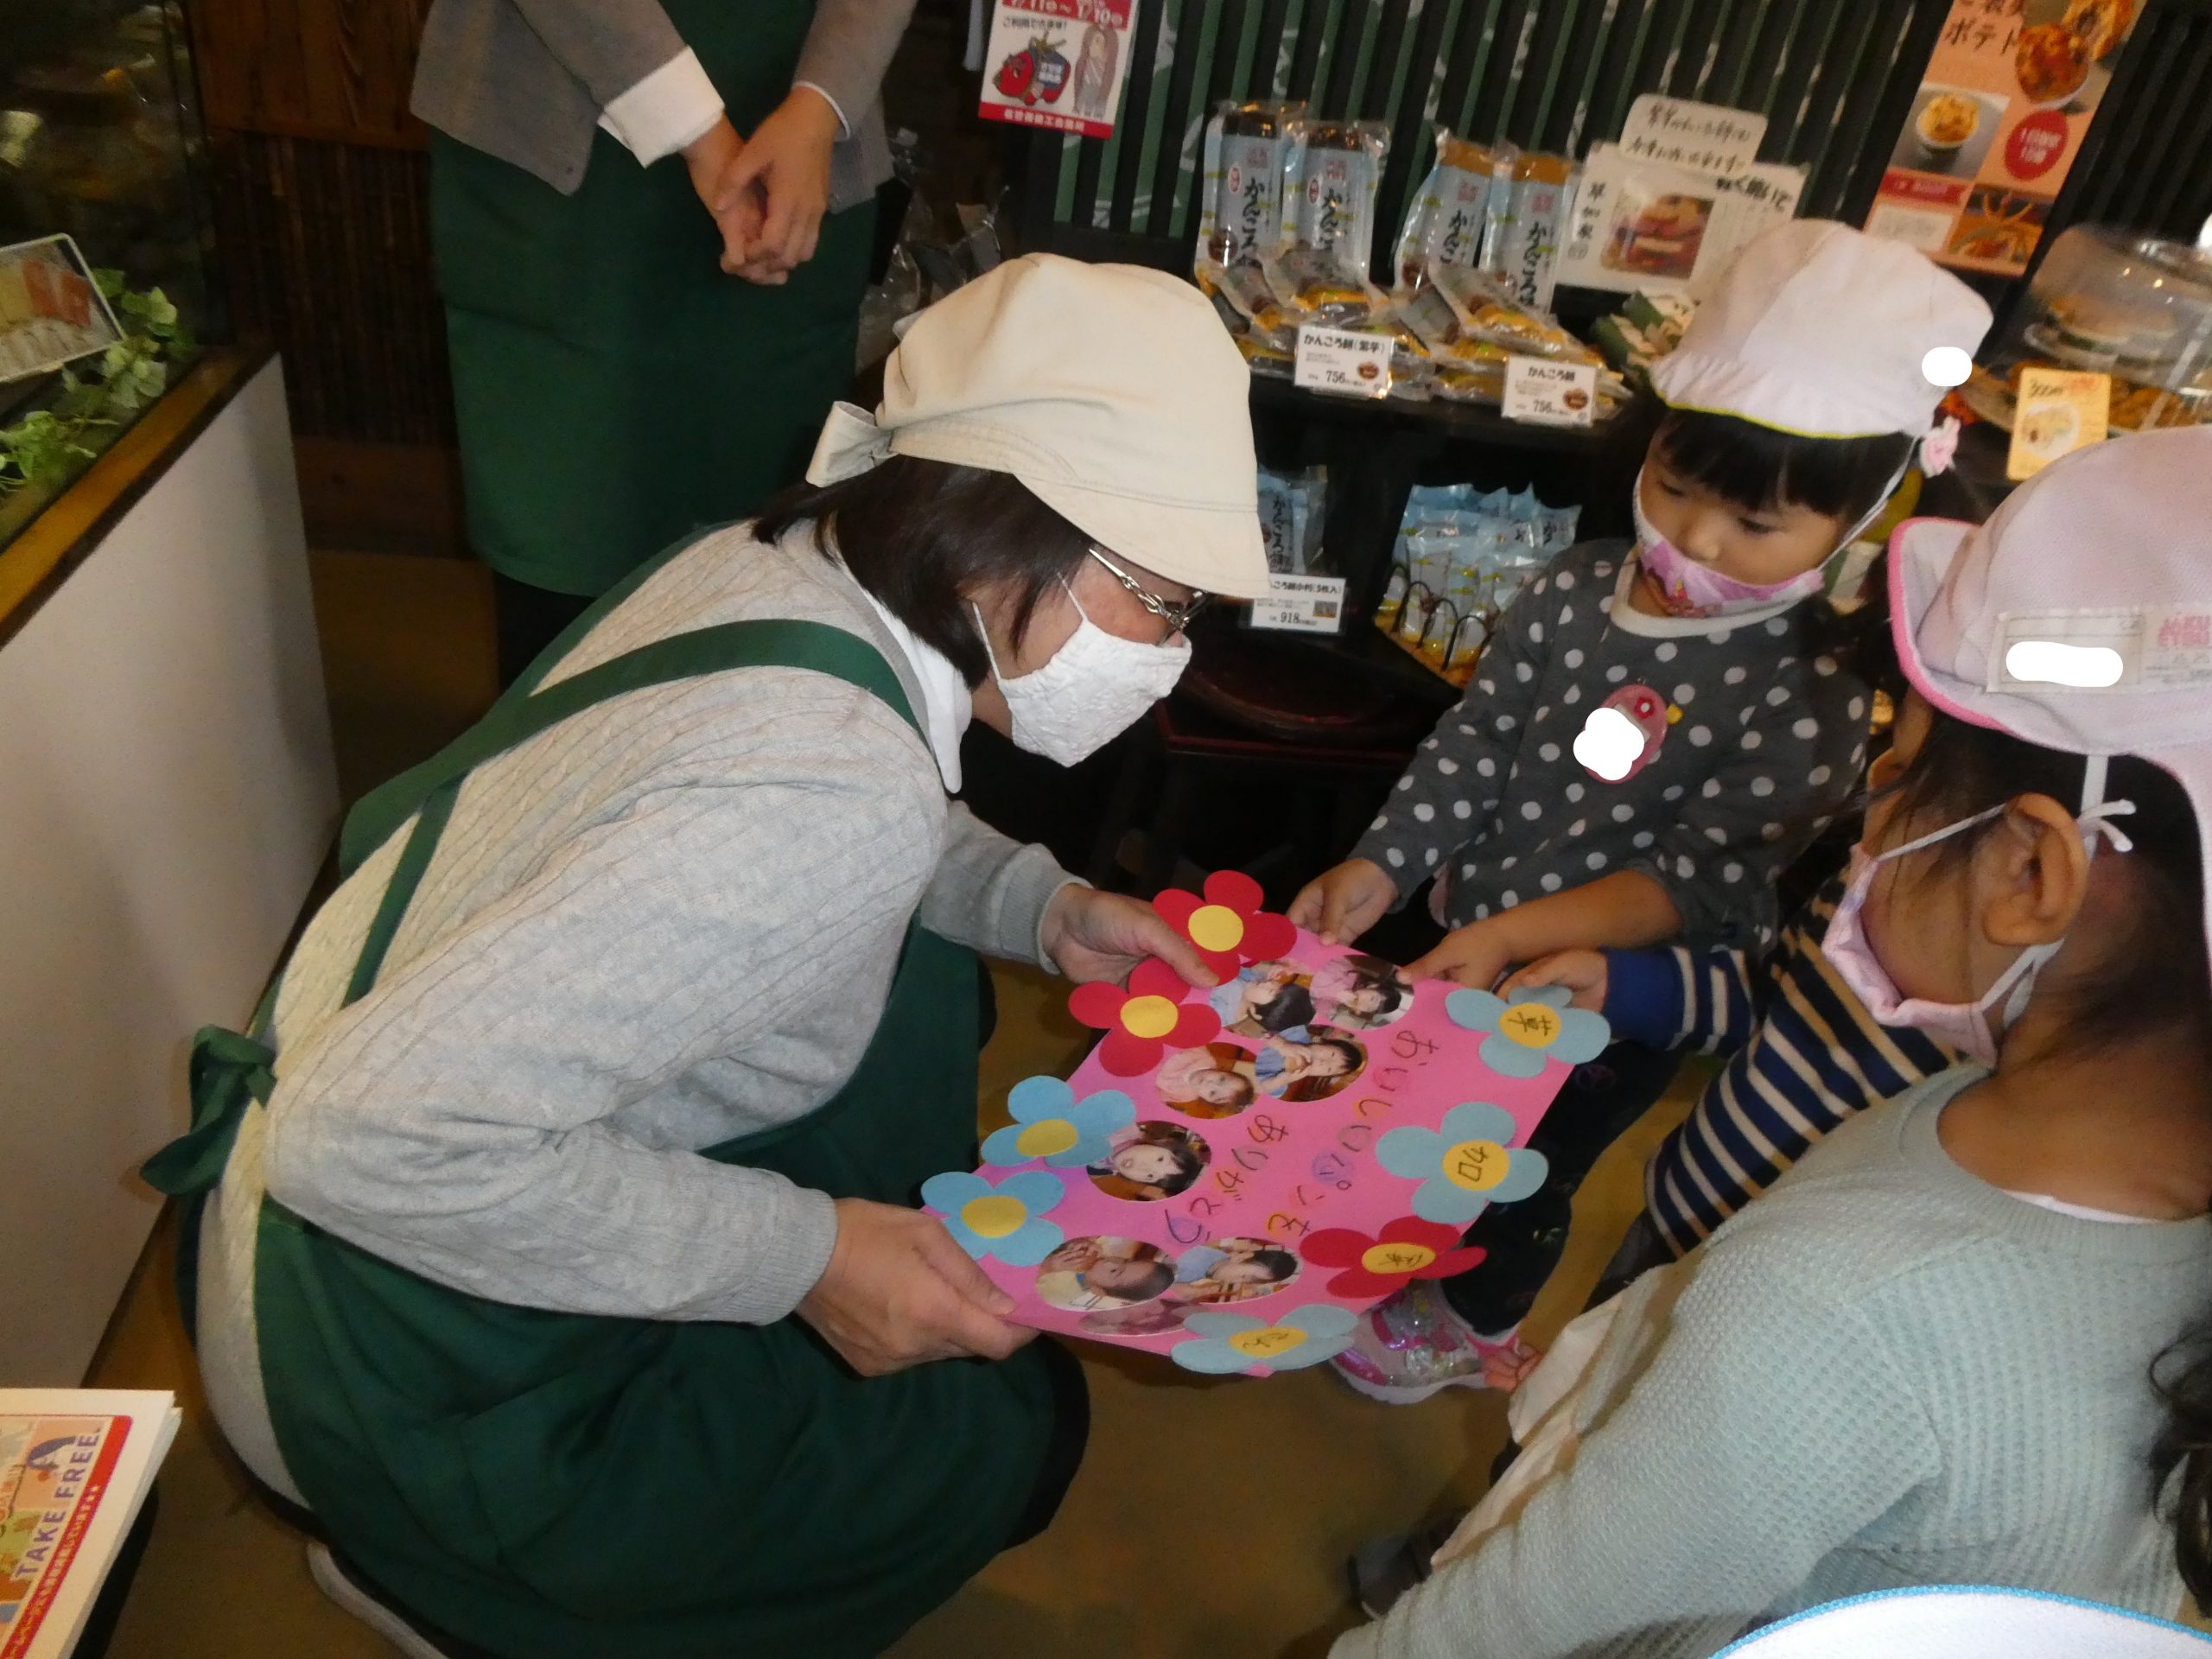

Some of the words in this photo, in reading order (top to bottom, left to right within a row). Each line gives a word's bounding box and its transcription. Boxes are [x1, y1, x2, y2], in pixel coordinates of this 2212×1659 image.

[1943, 17, 2018, 54] ポテト
[1241, 175, 1266, 264] かんころ
[1325, 370, 1346, 384] 756
[1280, 611, 1300, 624] 918
[1165, 1115, 1288, 1244] ありがとう
[1457, 1146, 1488, 1182] 加
[15, 1511, 66, 1577] TAKE
[54, 1428, 101, 1498] FREE.
